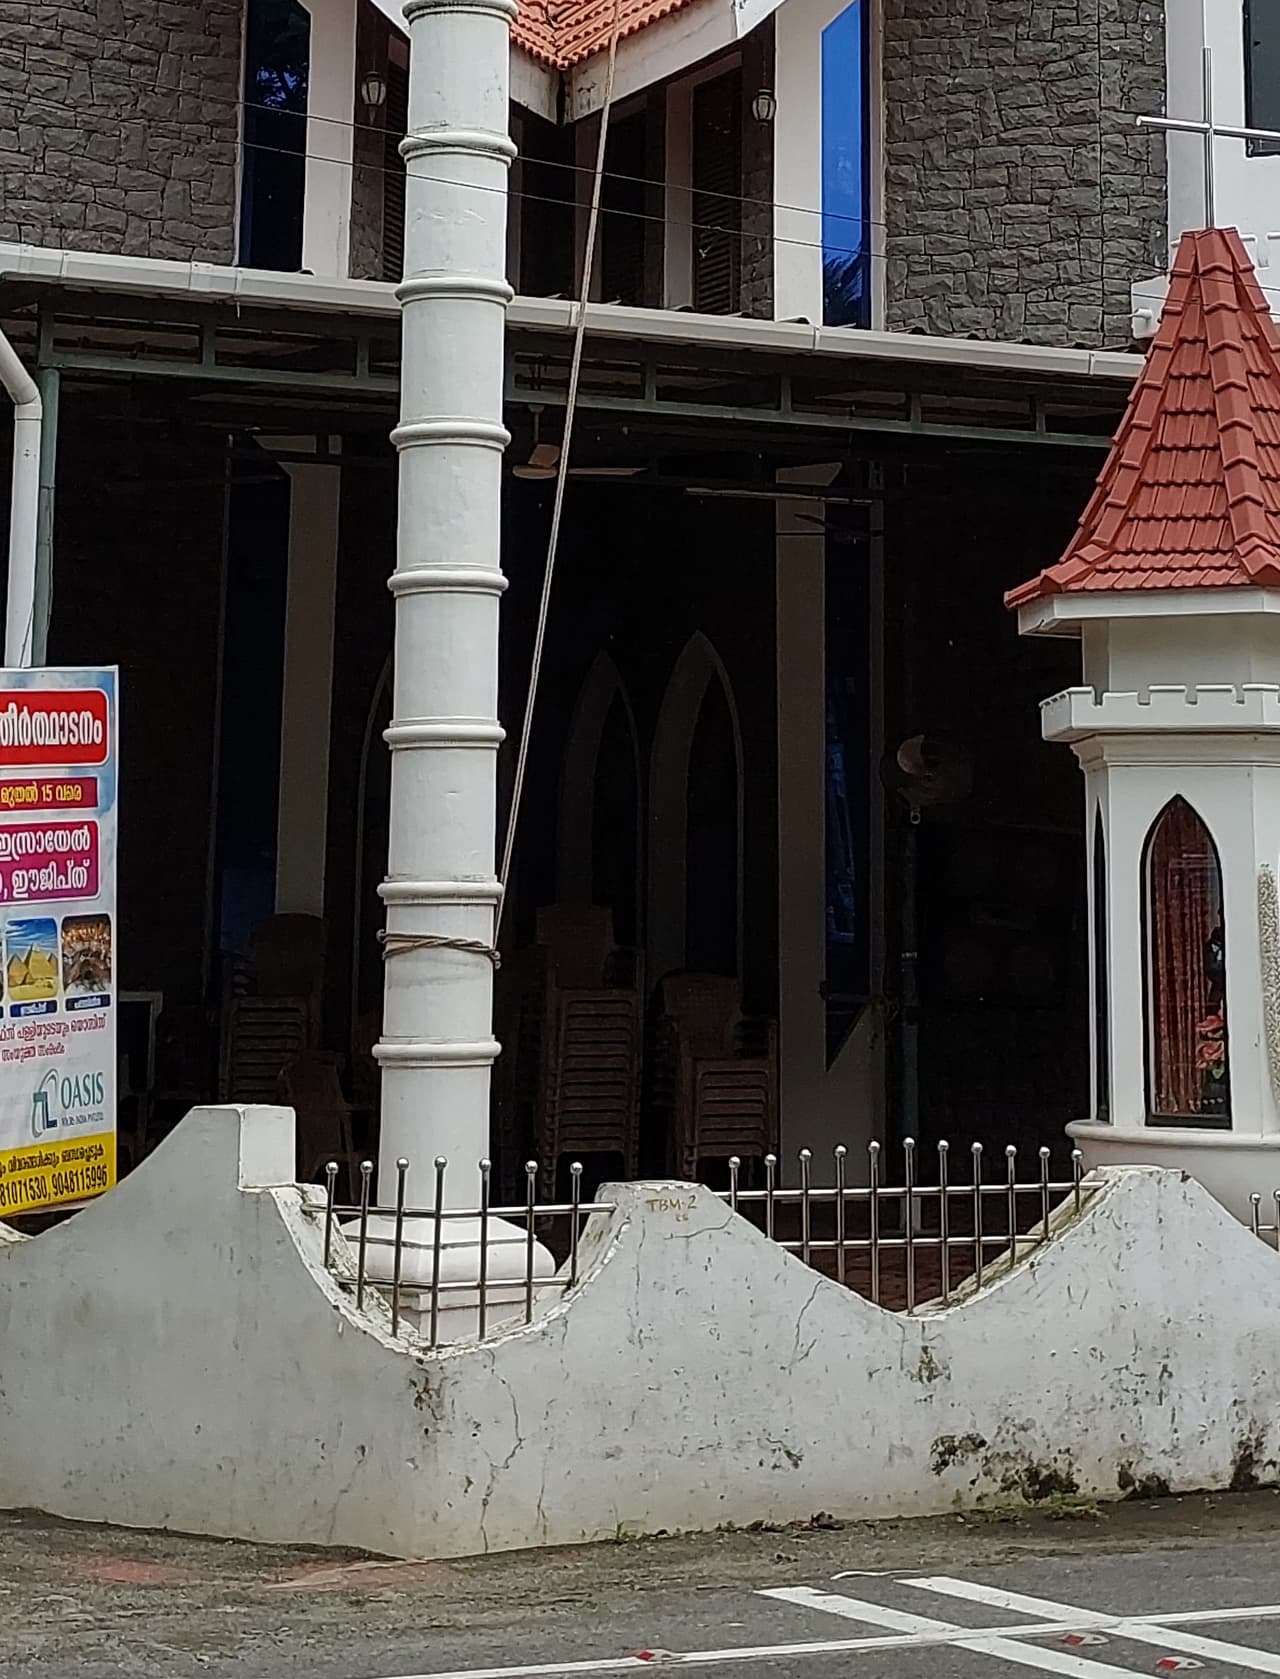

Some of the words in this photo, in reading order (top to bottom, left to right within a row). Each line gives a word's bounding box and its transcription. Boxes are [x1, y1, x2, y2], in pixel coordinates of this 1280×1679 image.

[1, 781, 39, 808] മുതൽ
[41, 784, 53, 803] 15
[55, 784, 82, 802] വരെ
[12, 859, 91, 899] ഈജിപ്ത്
[61, 1071, 104, 1110] OASIS
[51, 1165, 108, 1198] 9048115996
